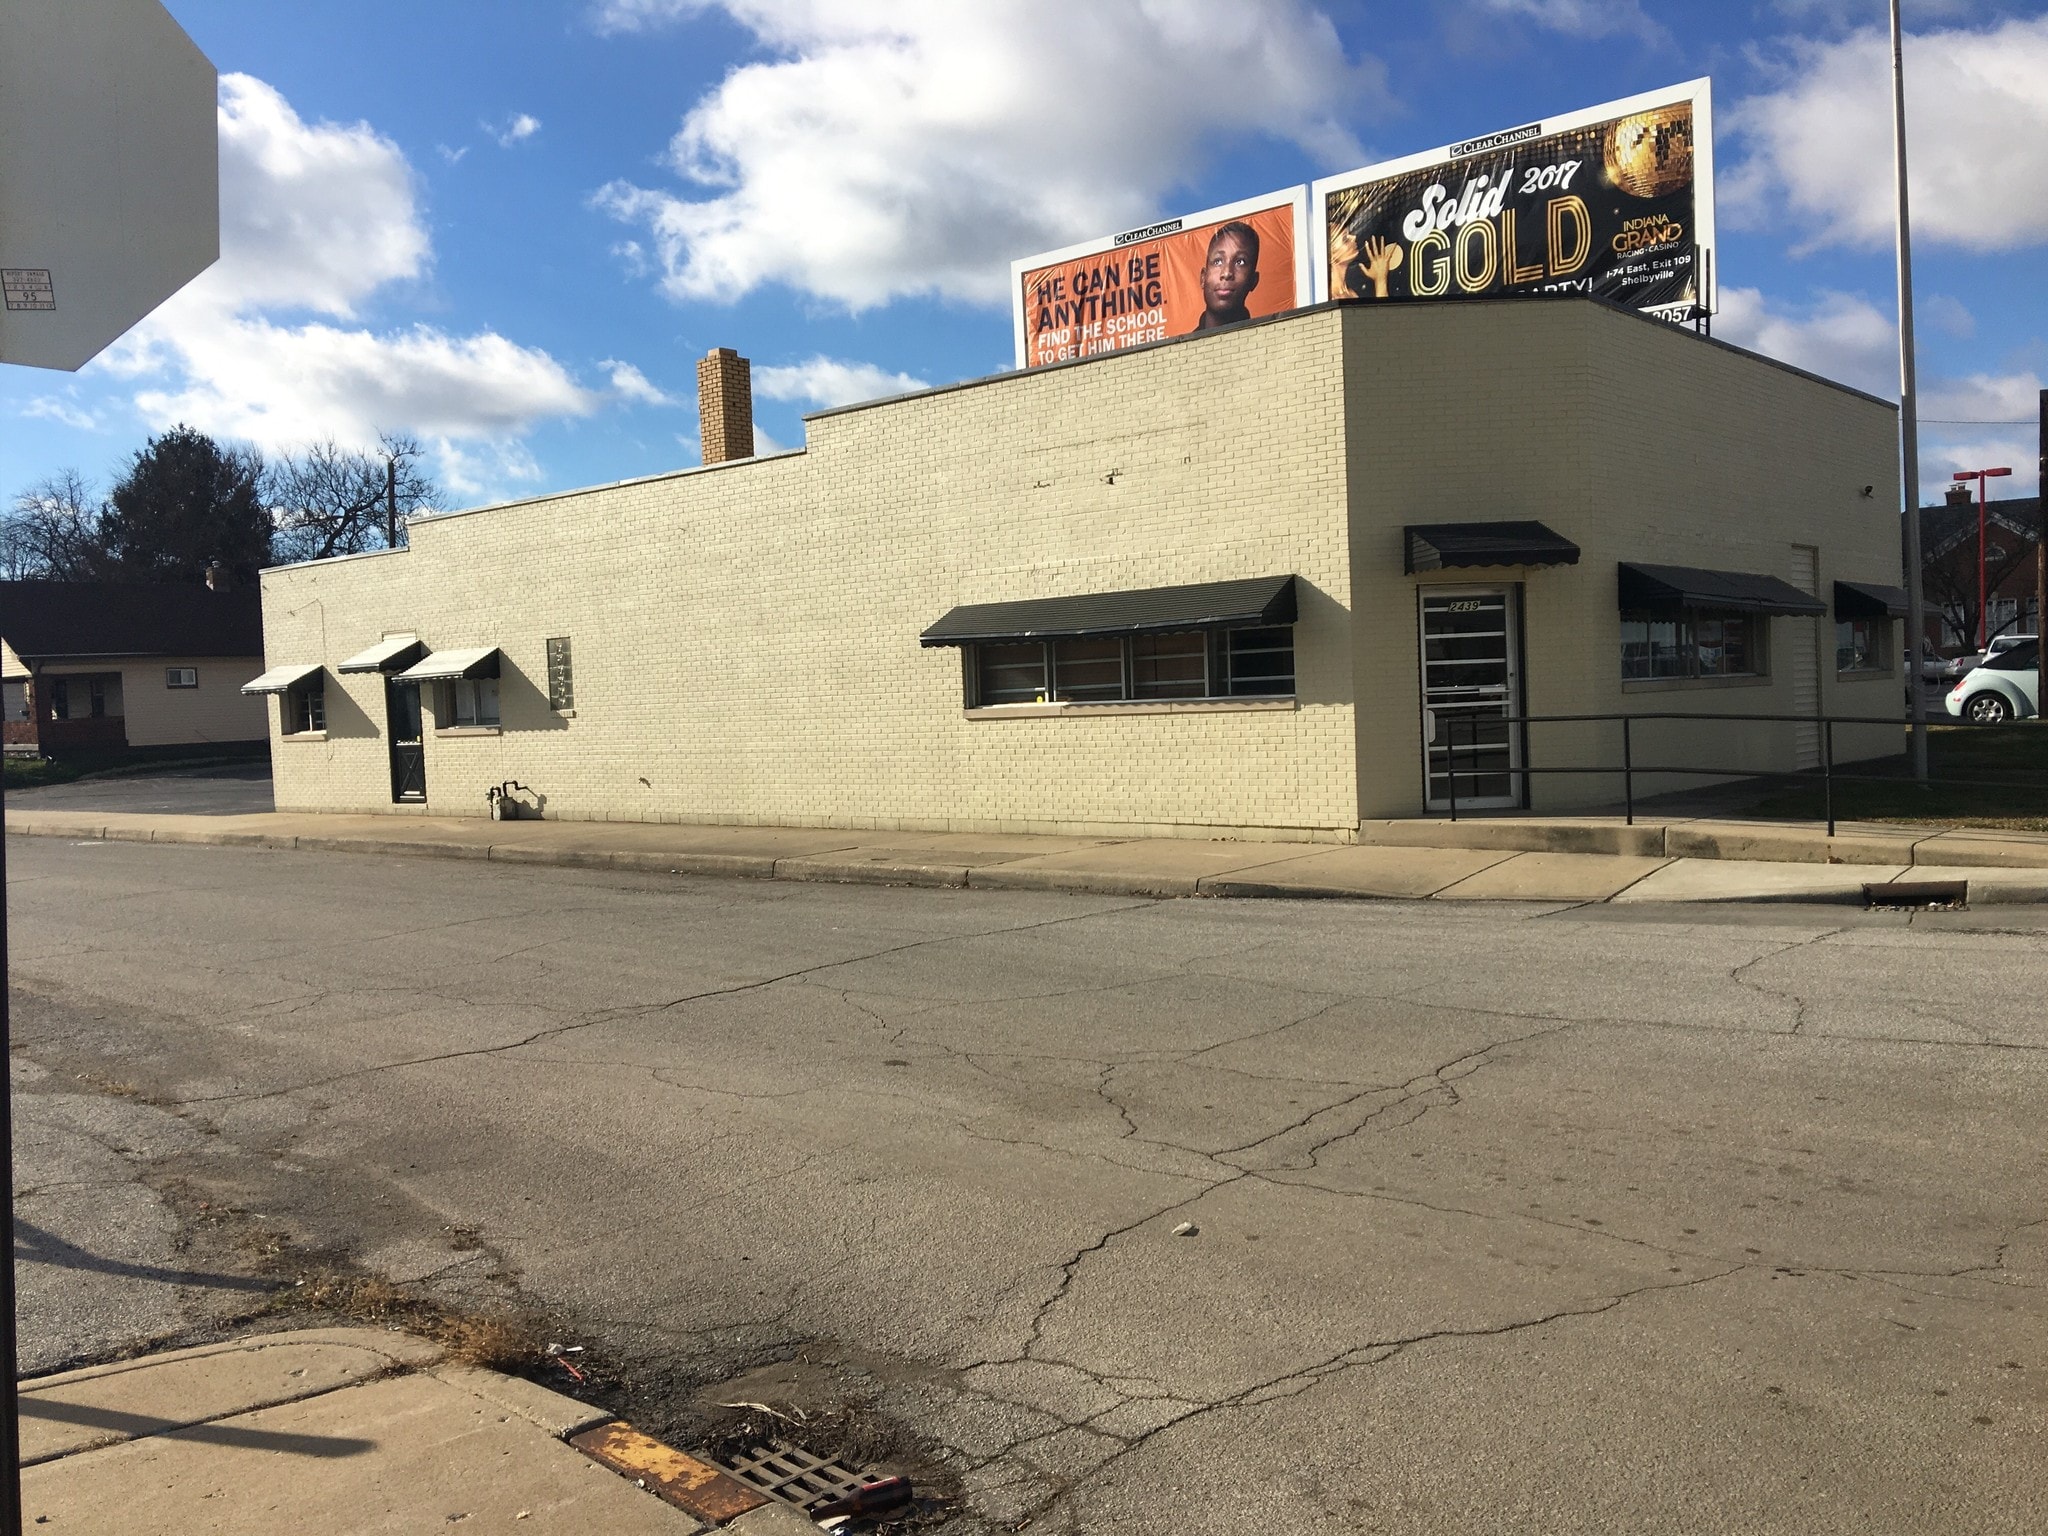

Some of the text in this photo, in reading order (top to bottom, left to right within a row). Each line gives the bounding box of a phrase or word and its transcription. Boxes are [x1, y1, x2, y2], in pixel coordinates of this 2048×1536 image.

[1403, 160, 1582, 241] Solid 2017
[1623, 213, 1669, 231] INDIANA
[1411, 195, 1591, 295] GOLD
[1612, 223, 1683, 251] GRAND
[1652, 259, 1672, 269] Exit
[1674, 255, 1691, 266] 109
[1037, 253, 1160, 305] HE CAN BE
[1621, 270, 1674, 286] Shelbyville
[1038, 280, 1168, 332] ANYTHING.
[1038, 308, 1167, 349] FIND THE SCHOOL
[1038, 350, 1054, 365] TO
[1058, 343, 1084, 361] GET
[1088, 337, 1115, 356] HIM
[1450, 601, 1479, 611] 2439
